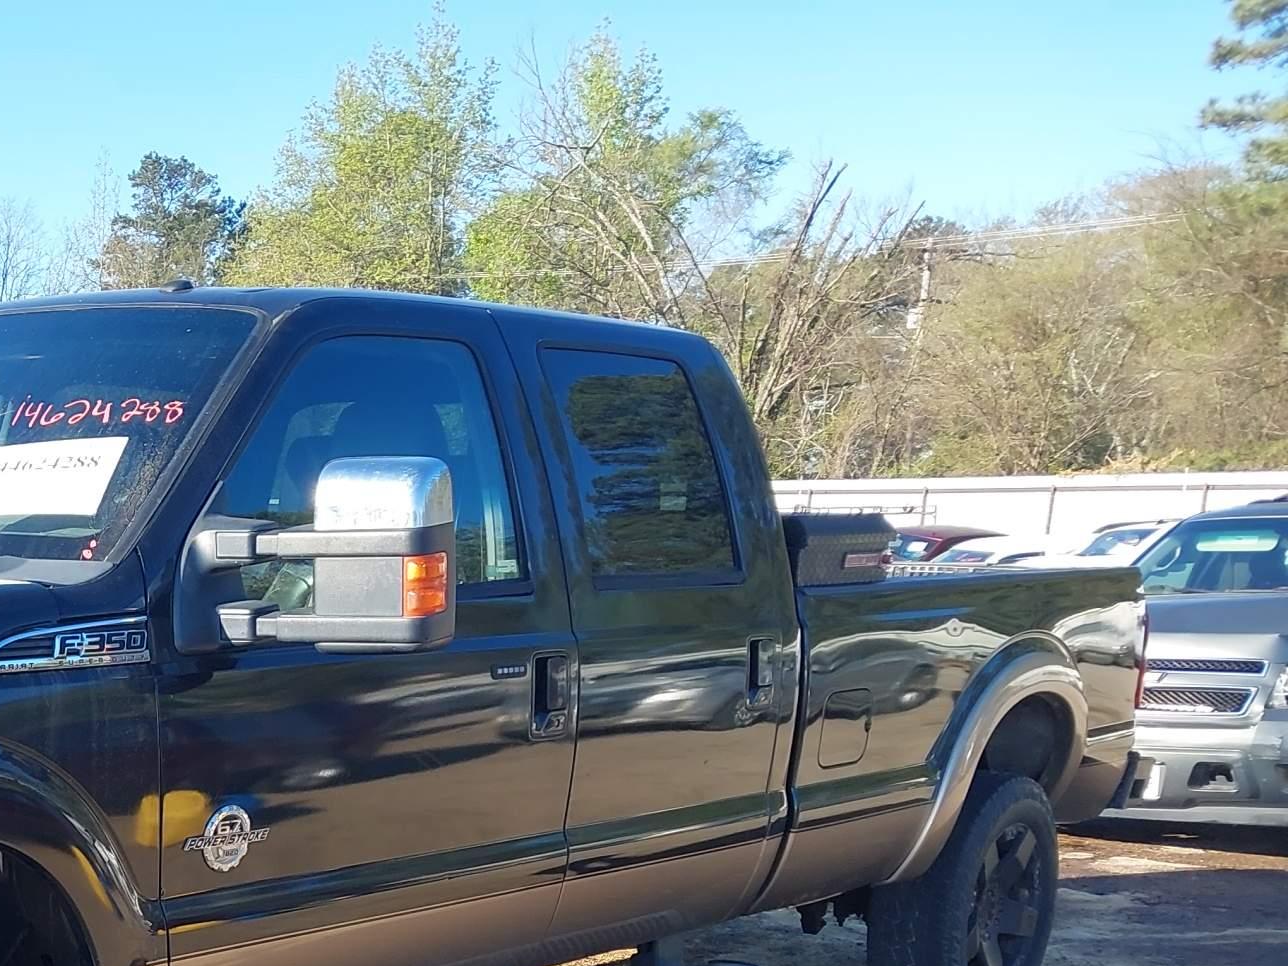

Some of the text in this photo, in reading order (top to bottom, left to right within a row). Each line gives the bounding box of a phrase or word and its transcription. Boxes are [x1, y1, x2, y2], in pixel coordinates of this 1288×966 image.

[58, 656, 104, 666] SUPER
[184, 828, 270, 851] POWER STROKE
